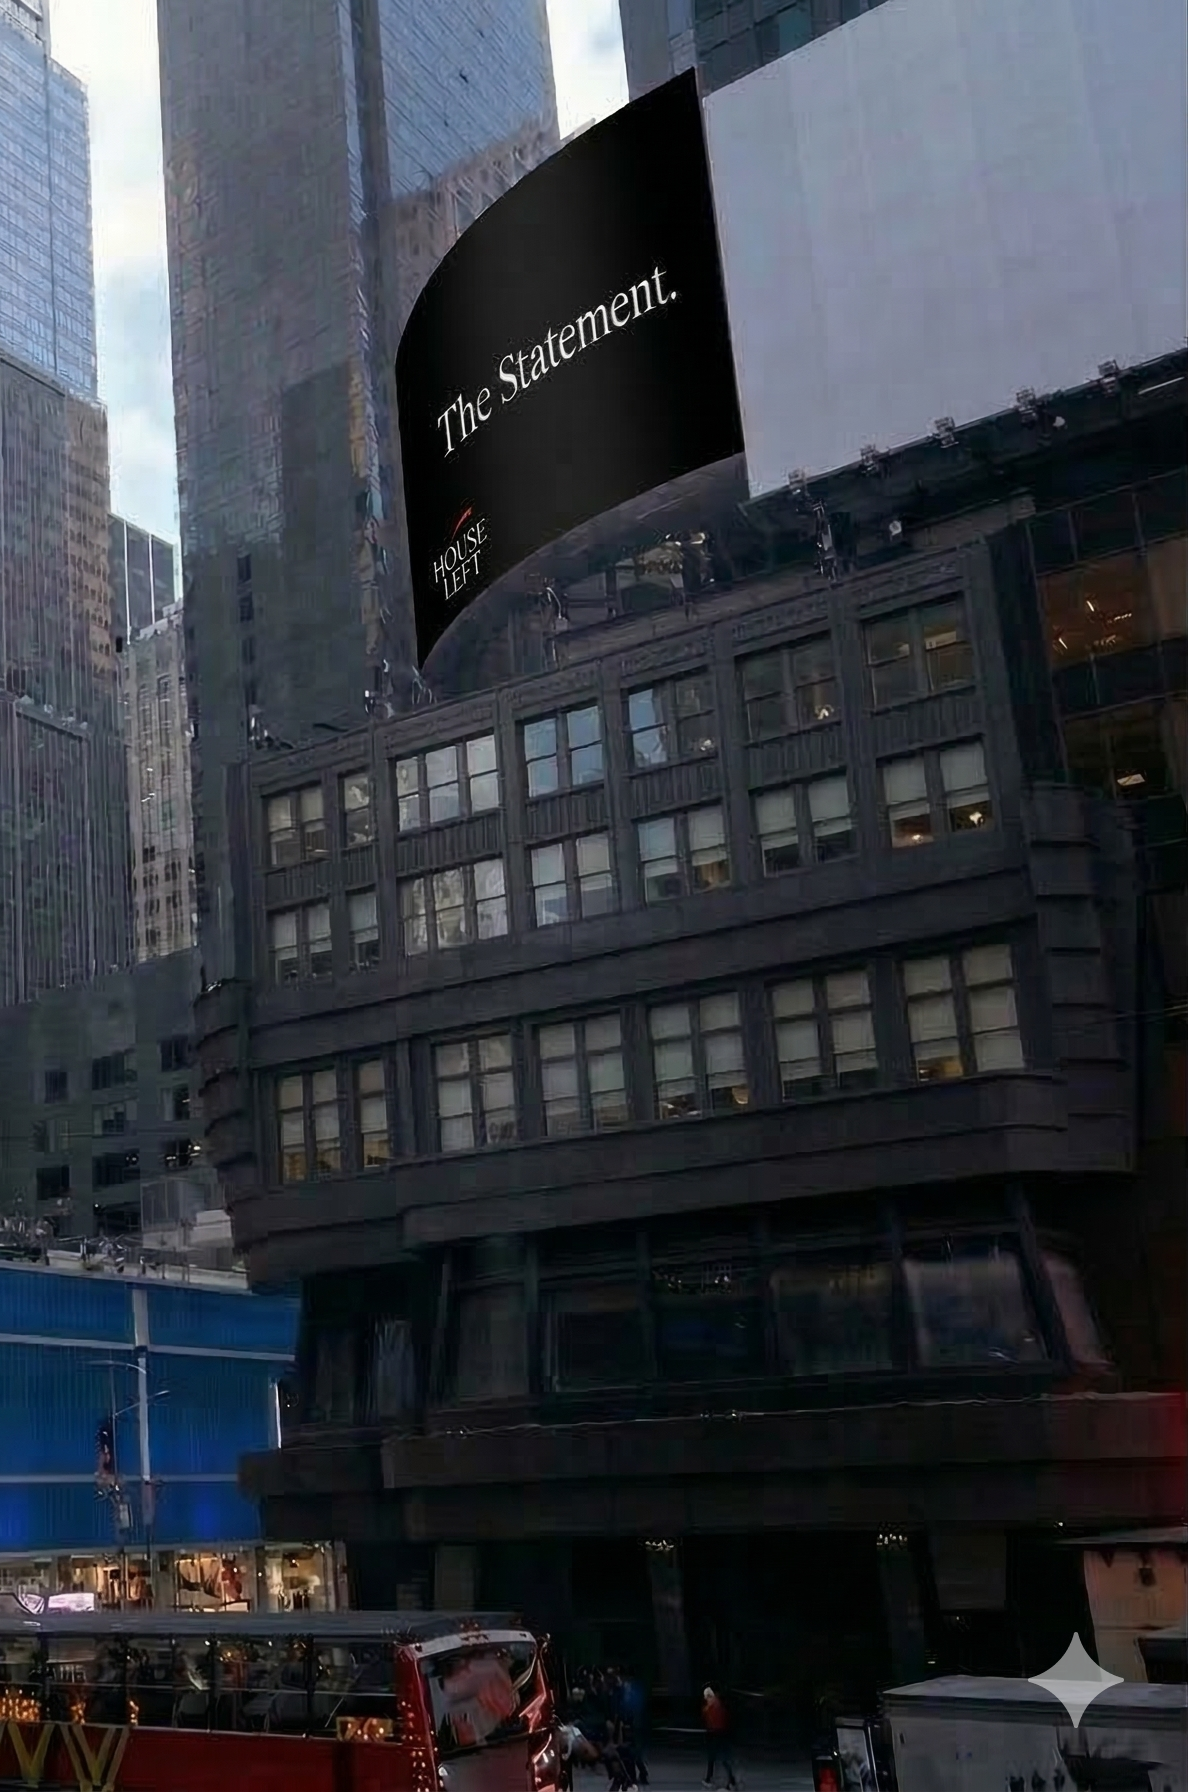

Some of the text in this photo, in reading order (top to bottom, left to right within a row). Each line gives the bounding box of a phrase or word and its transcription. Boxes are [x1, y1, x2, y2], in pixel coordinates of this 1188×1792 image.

[437, 266, 678, 458] The Statement.
[433, 517, 488, 584] HOUSE
[443, 549, 481, 601] LEFT
